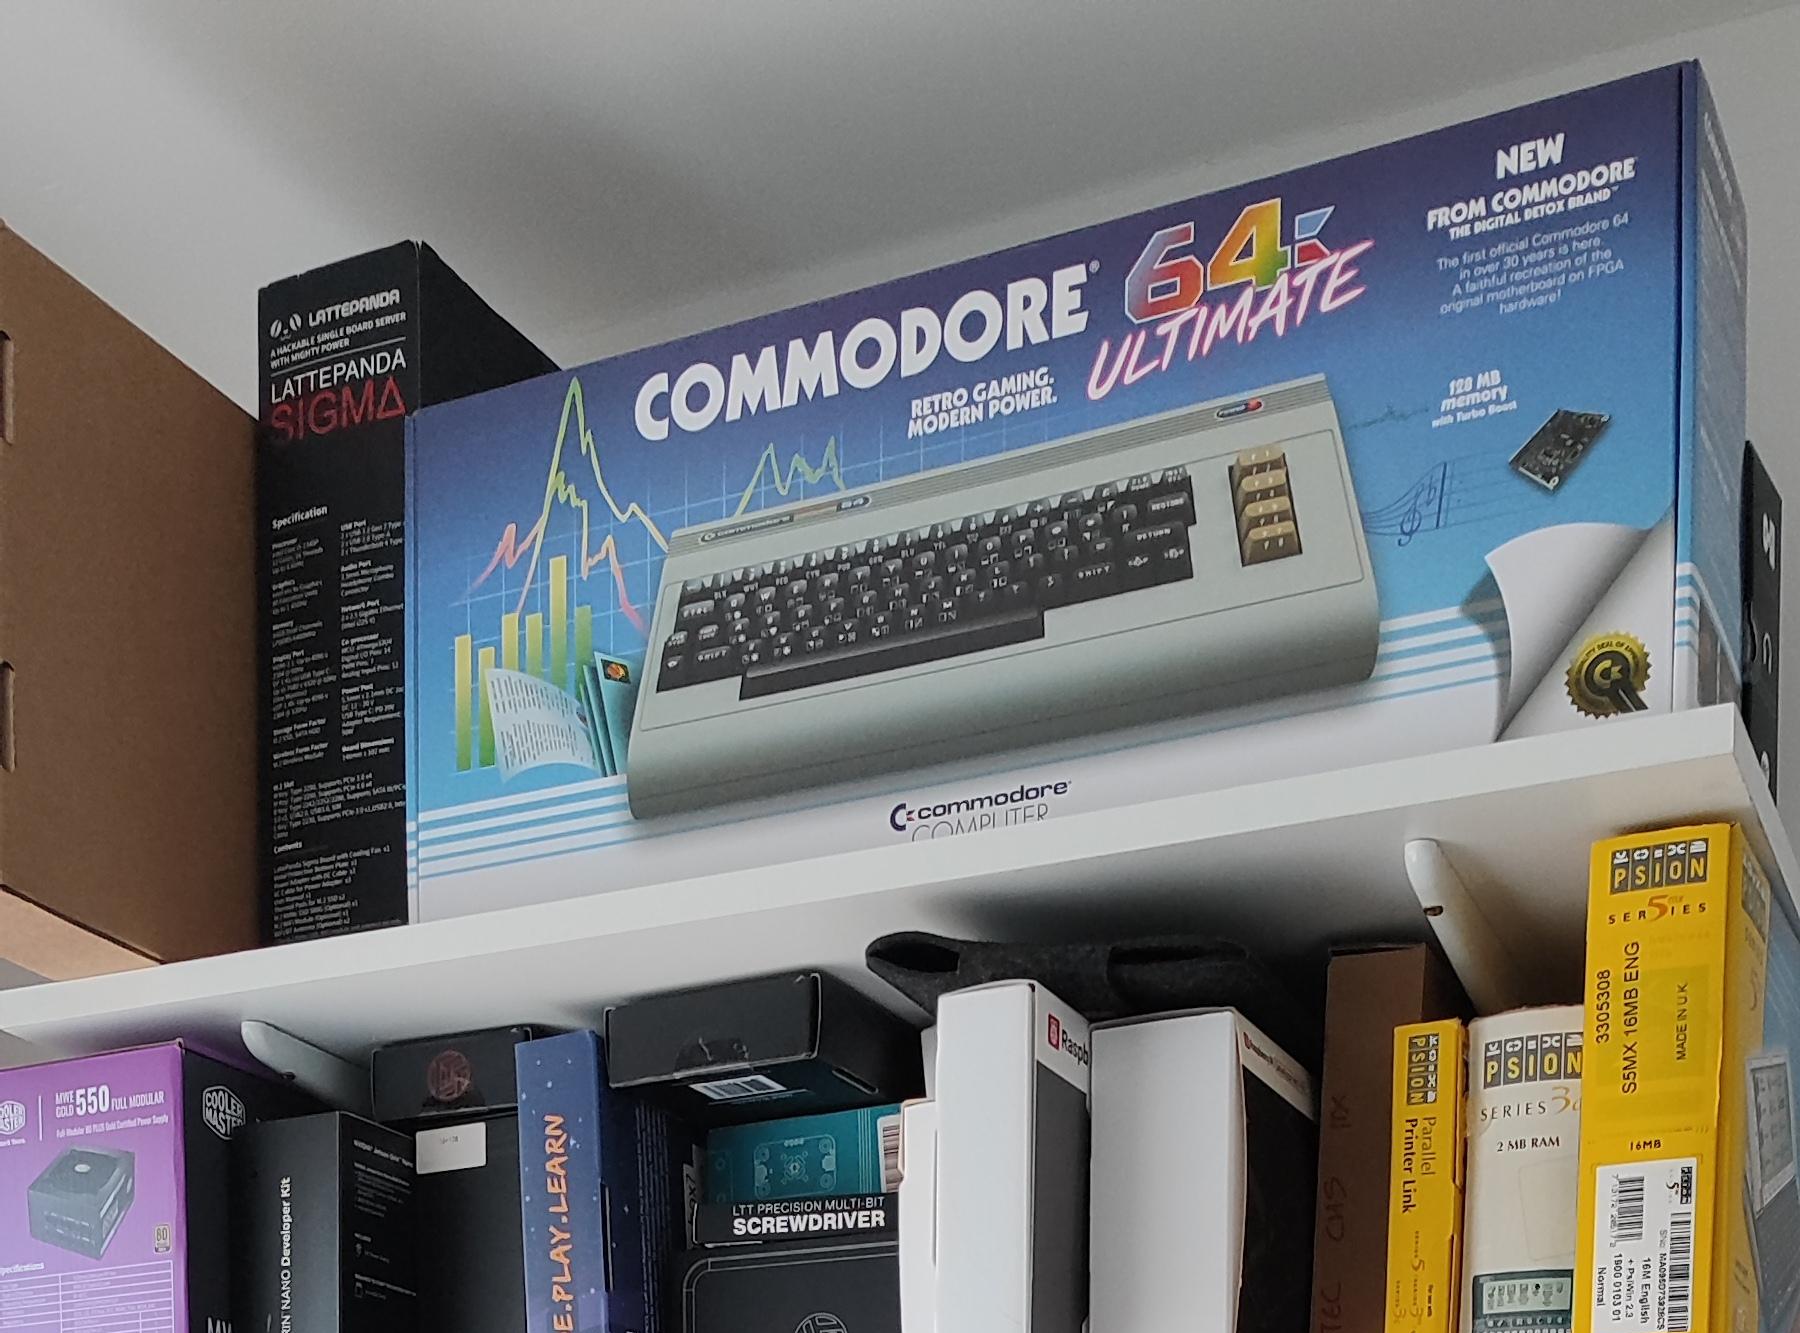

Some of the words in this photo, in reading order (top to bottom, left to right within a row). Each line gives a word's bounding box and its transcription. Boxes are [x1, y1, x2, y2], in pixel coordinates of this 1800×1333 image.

[1496, 133, 1565, 180] NEW
[1426, 197, 1486, 231] FROM
[1491, 158, 1636, 213] COMMODORE
[1449, 223, 1471, 241] THE
[1474, 210, 1521, 235] DIGITAL
[1524, 198, 1566, 222] DETOX
[1436, 257, 1459, 272] The
[1462, 247, 1487, 264] first
[1489, 237, 1529, 258] official
[1532, 219, 1610, 247] Commodore
[1612, 211, 1629, 227] 64
[1473, 262, 1500, 276] over
[1503, 255, 1519, 269] 30
[1522, 245, 1555, 266] years
[1440, 292, 1484, 314] original
[1486, 273, 1565, 304] motherboard
[1588, 258, 1625, 279] FPGA
[1452, 282, 1463, 297] A
[1465, 271, 1508, 294] faithful
[1509, 257, 1572, 283] recreation
[1590, 247, 1613, 262] the
[308, 289, 400, 328] LATTEPANDA
[1087, 240, 1375, 401] ULTIMATE
[1500, 288, 1562, 314] hardware!
[271, 354, 290, 370] WITH
[291, 345, 320, 363] MIGHTY
[321, 337, 350, 354] POWER
[277, 333, 316, 357] HACKABLE
[317, 325, 344, 344] SINGLE
[346, 319, 374, 336] BOARD
[375, 311, 407, 328] SERVER
[271, 348, 407, 405] LATTEPANDA
[911, 387, 968, 420] RETRO
[973, 366, 1055, 402] GAMING.
[1476, 369, 1501, 389] MB
[908, 402, 984, 440] MODERN
[988, 386, 1057, 418] POWER.
[1440, 385, 1508, 412] memory
[272, 505, 328, 531] Specification
[1624, 941, 1640, 982] ENG
[1596, 969, 1612, 1044] 3305308
[1623, 988, 1639, 1037] 16MB
[1677, 1003, 1687, 1022] IN
[1676, 1024, 1686, 1061] MADE
[1622, 1040, 1638, 1095] S5MX
[56, 1090, 74, 1106] MWE
[56, 1104, 74, 1119] GOLD
[75, 1085, 110, 1116] 550
[111, 1096, 128, 1111] FULL
[129, 1091, 164, 1106] MODULAR
[204, 1091, 245, 1118] COOLER
[1480, 1101, 1547, 1121] SERIES
[1402, 1117, 1418, 1175] Printer
[1420, 1116, 1437, 1176] Parallel
[1508, 1138, 1526, 1152] MB
[1531, 1136, 1560, 1149] RAM
[1629, 1138, 1662, 1152] 16MB
[280, 1176, 292, 1199] Kit
[732, 1204, 754, 1217] LTT
[757, 1200, 823, 1215] PRECISION
[825, 1196, 885, 1212] MULTI-BIT
[1402, 1178, 1416, 1214] Link
[280, 1201, 293, 1267] Developer
[732, 1209, 885, 1236] SCREWDRIVER
[1597, 1267, 1607, 1307] Normal
[1642, 1257, 1652, 1282] 16M
[281, 1269, 292, 1312] NANO
[1640, 1283, 1651, 1325] English
